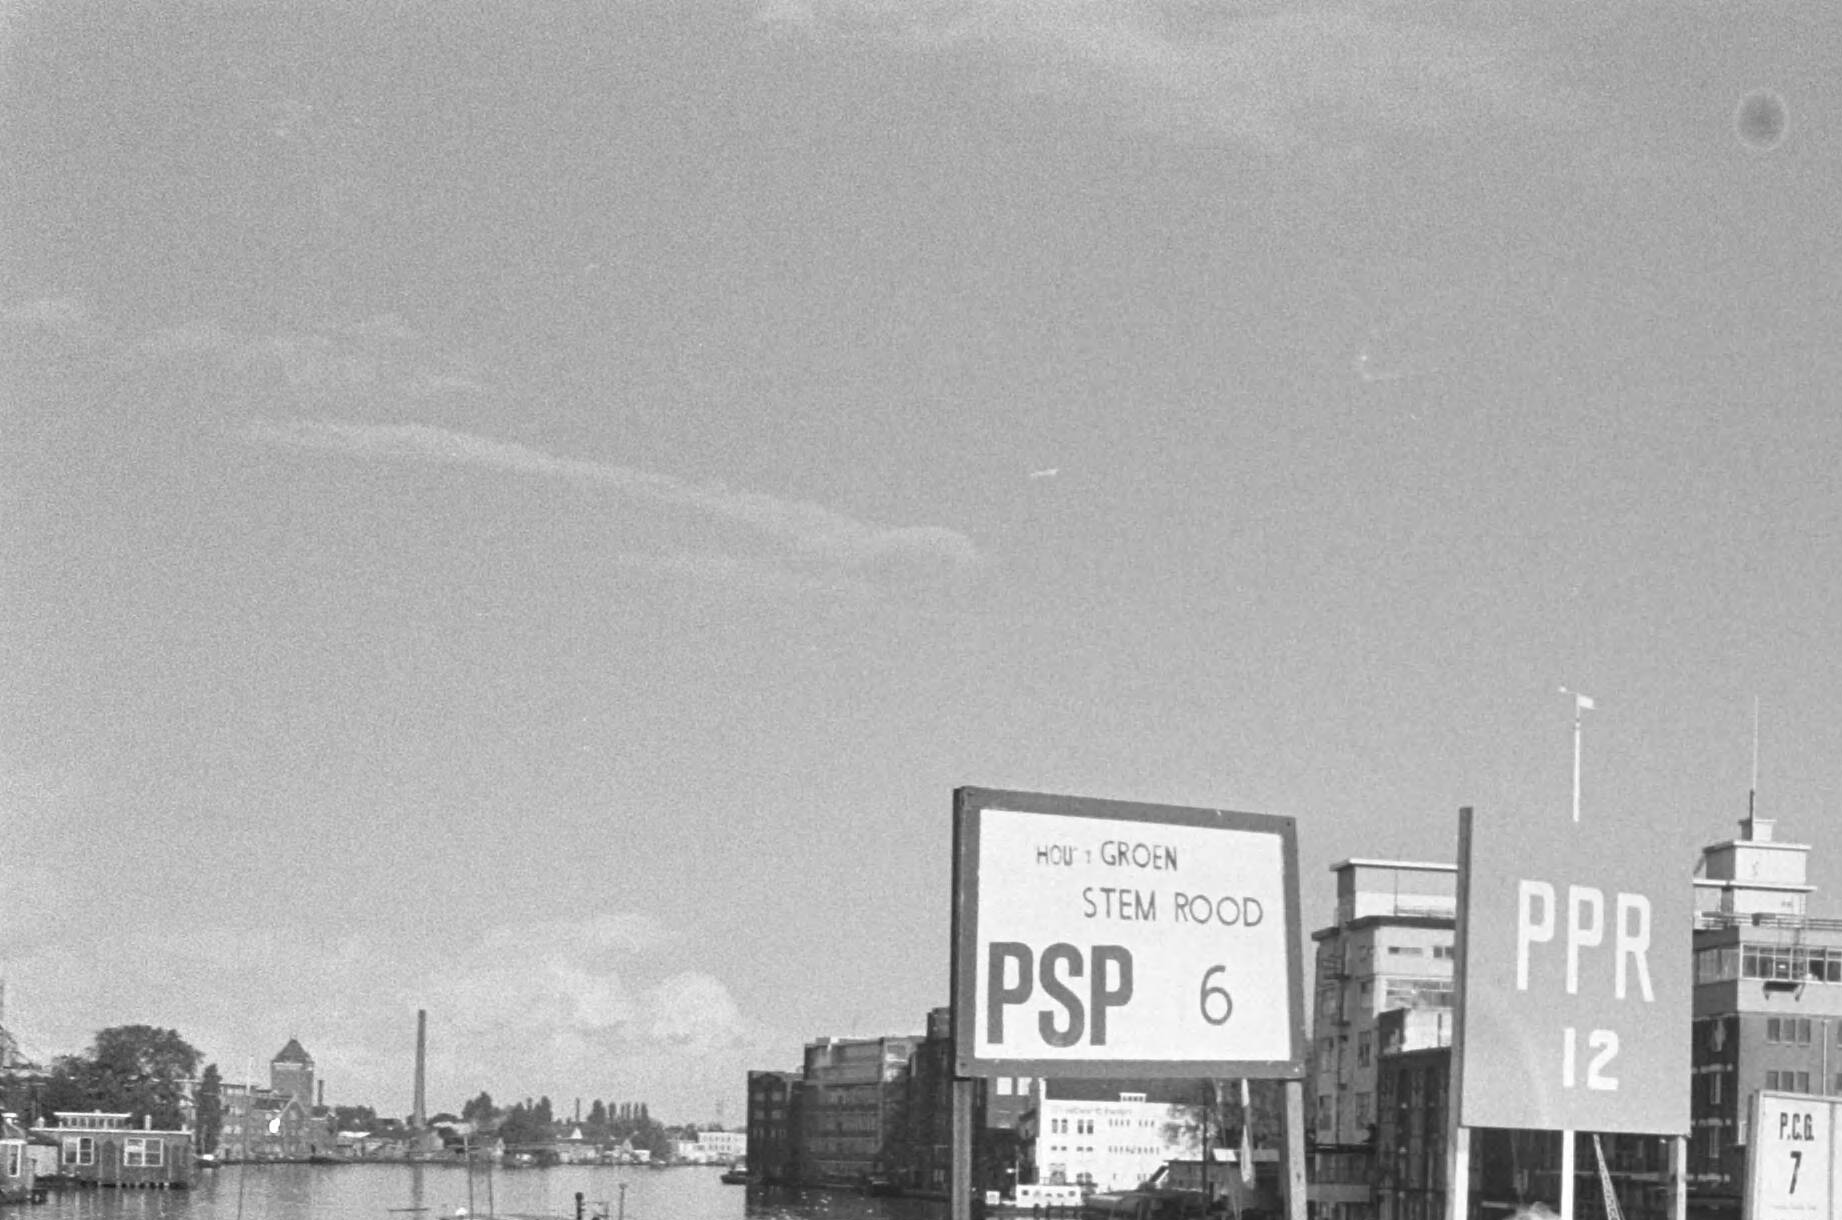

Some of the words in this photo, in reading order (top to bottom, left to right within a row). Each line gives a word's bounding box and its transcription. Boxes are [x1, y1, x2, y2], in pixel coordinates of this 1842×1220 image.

[1101, 841, 1178, 871] GROEN
[1083, 887, 1156, 921] STEM
[1175, 892, 1263, 927] ROOD
[1517, 878, 1655, 1002] PPR
[987, 941, 1134, 1048] PSP
[1200, 965, 1232, 1026] 6
[1562, 1026, 1620, 1090] 12
[1789, 1151, 1802, 1194] 7
